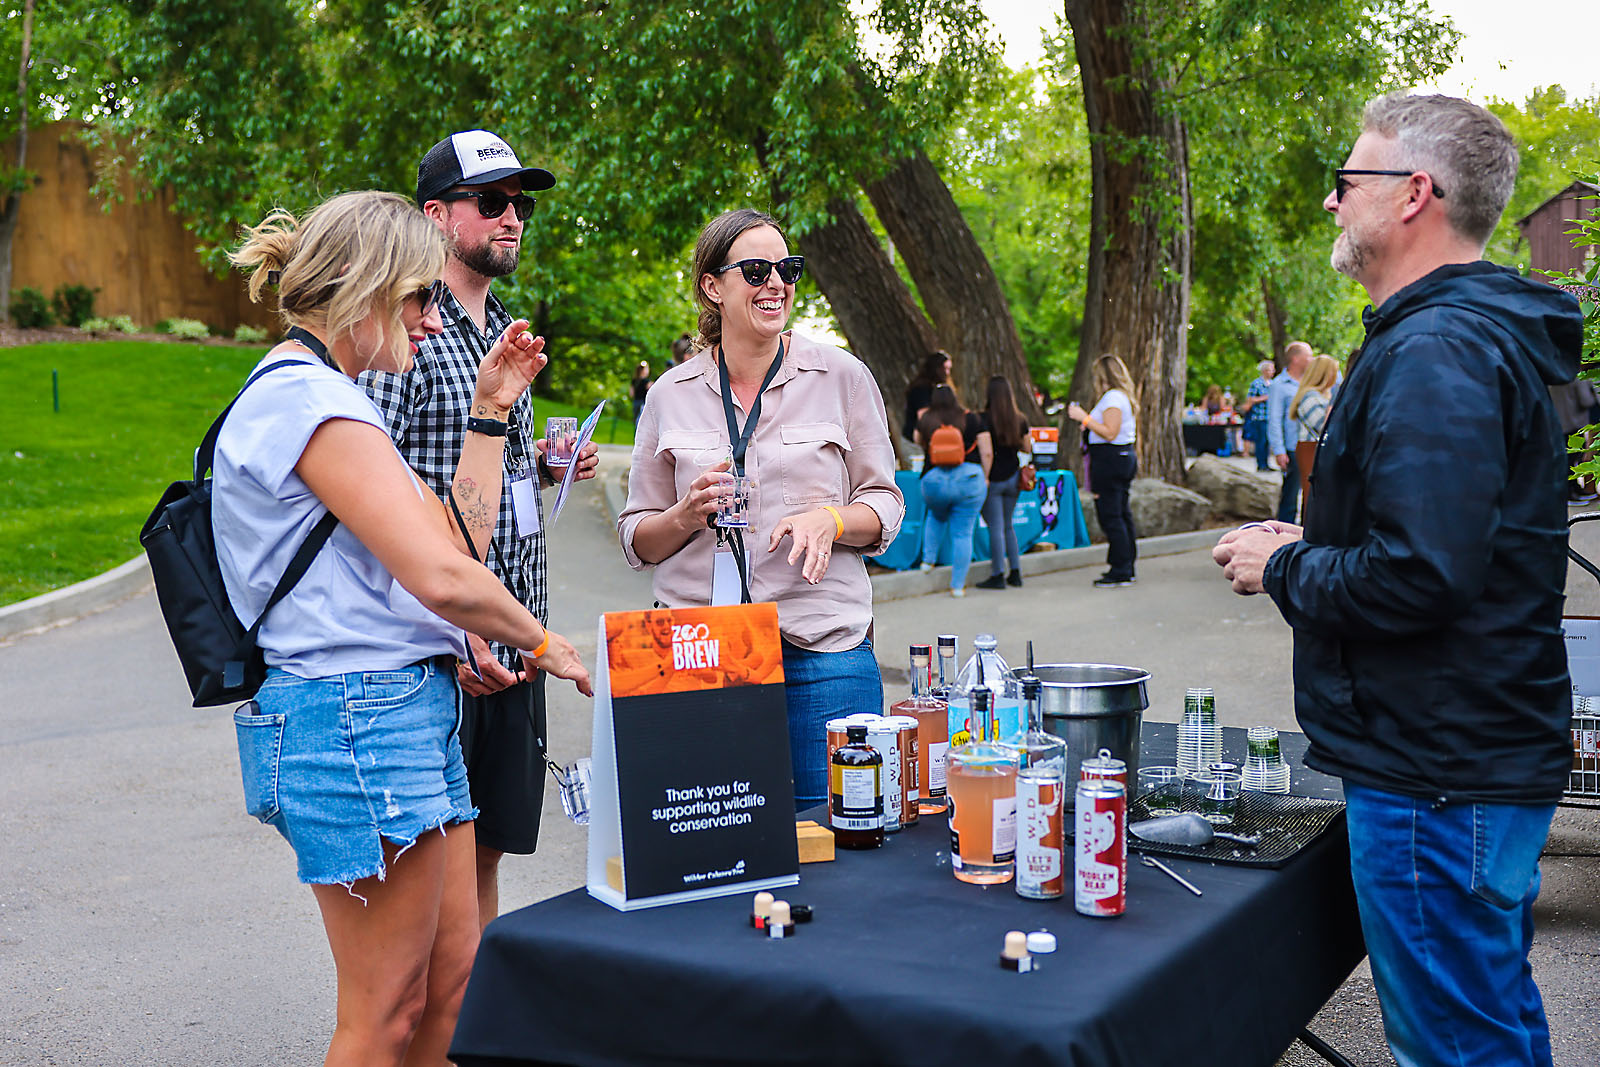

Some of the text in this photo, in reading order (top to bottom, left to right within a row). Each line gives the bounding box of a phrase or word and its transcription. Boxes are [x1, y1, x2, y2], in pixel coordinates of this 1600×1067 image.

[671, 623, 709, 641] ZOO
[672, 639, 719, 669] BREW
[666, 780, 750, 802] Thank you for
[652, 793, 765, 821] supporting wildlife
[670, 812, 752, 833] conservation
